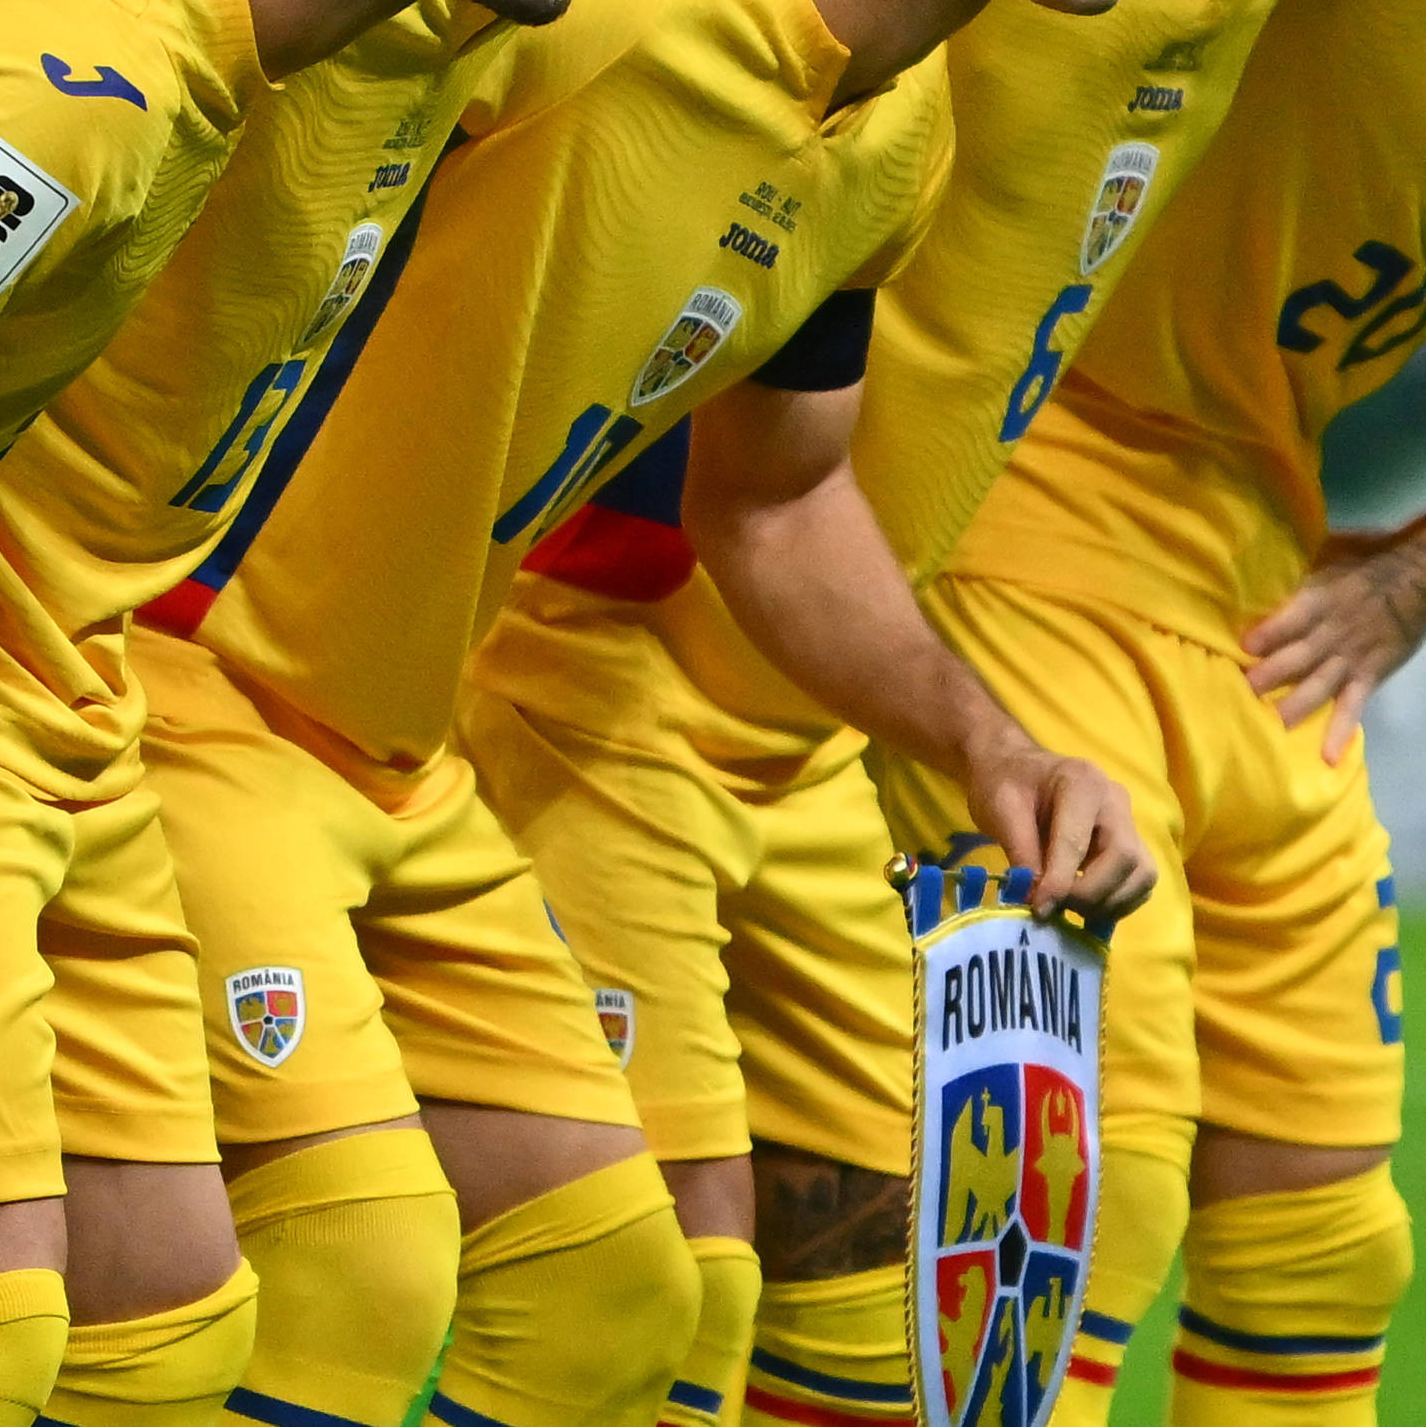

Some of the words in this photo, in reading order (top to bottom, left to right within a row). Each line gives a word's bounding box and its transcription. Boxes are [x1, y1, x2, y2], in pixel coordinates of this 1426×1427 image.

[998, 284, 1095, 444] 6
[232, 968, 295, 994] ROMÂNIA
[594, 989, 627, 1009] ÂNIA
[941, 926, 1083, 1056] ROMÂNIA
